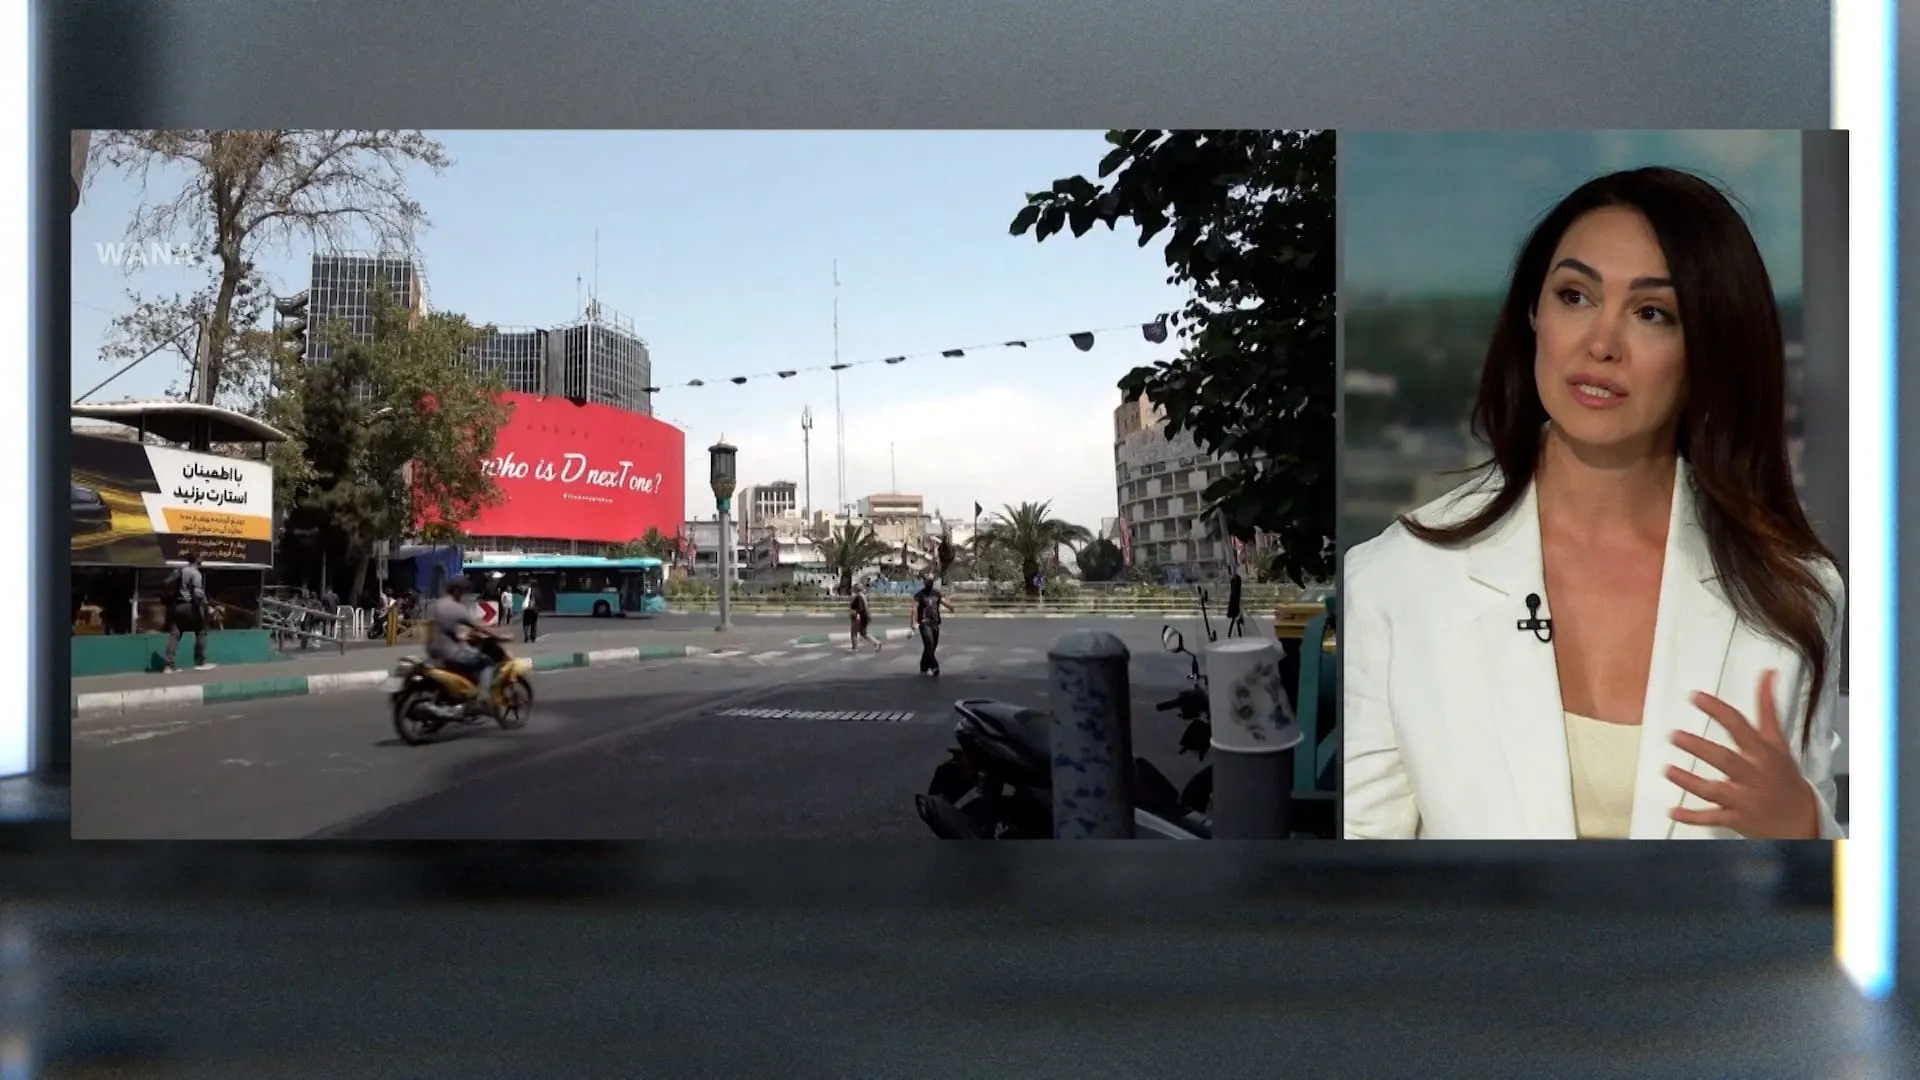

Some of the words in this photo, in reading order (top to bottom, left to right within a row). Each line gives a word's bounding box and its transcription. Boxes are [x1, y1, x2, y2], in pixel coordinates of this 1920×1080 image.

[182, 462, 233, 483] اطمینان
[234, 467, 243, 487] با
[535, 459, 555, 481] is
[561, 453, 587, 483] D
[630, 473, 662, 494] one?
[173, 486, 205, 505] بزنید
[206, 488, 247, 506] استارت
